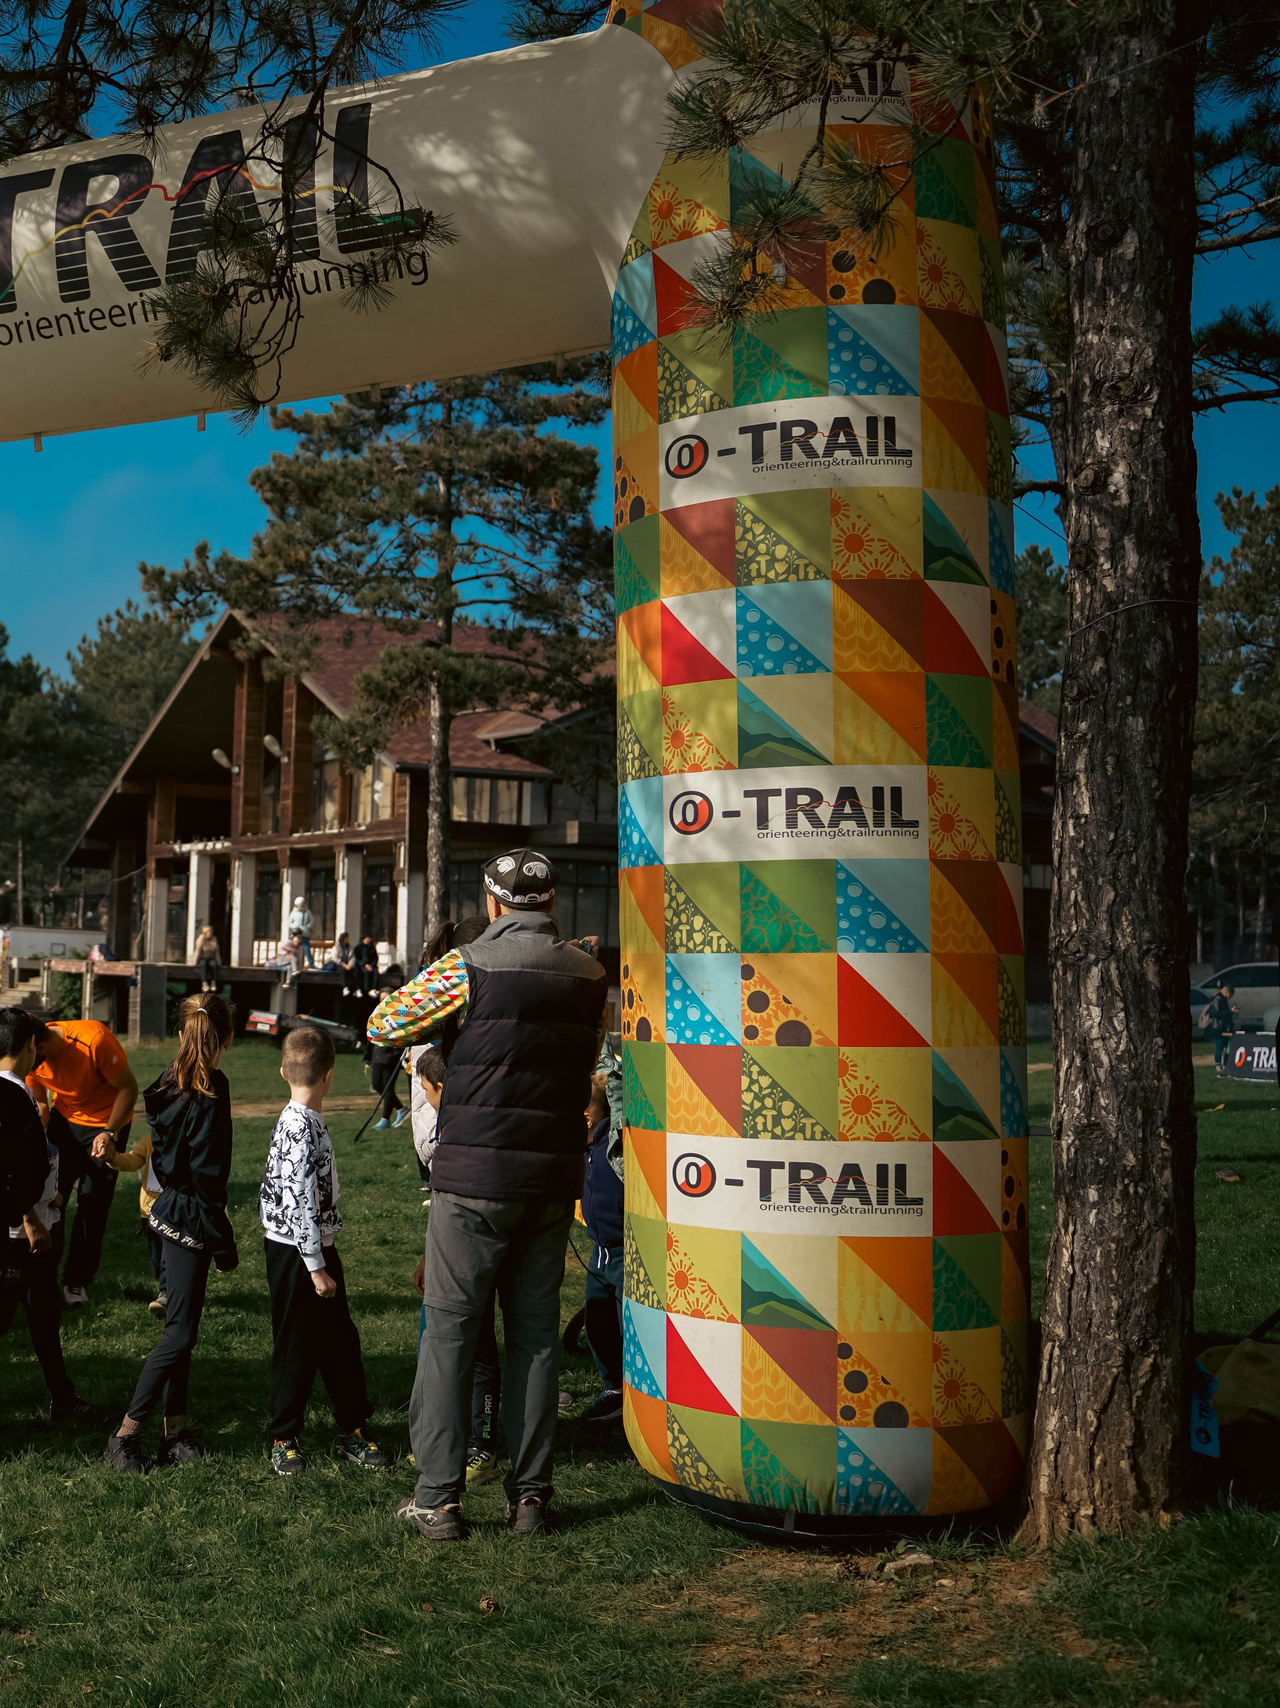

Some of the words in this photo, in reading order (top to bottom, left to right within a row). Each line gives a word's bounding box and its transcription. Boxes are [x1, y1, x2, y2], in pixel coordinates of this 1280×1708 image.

[752, 456, 913, 474] orienteering&trailrunning
[757, 827, 920, 840] orienteering&trailrunning
[1234, 1045, 1278, 1068] O-TRA
[759, 1203, 924, 1217] orienteering&trailrunning
[158, 1223, 180, 1240] FILA
[484, 1394, 492, 1414] PRO
[482, 1415, 491, 1439] FILA
